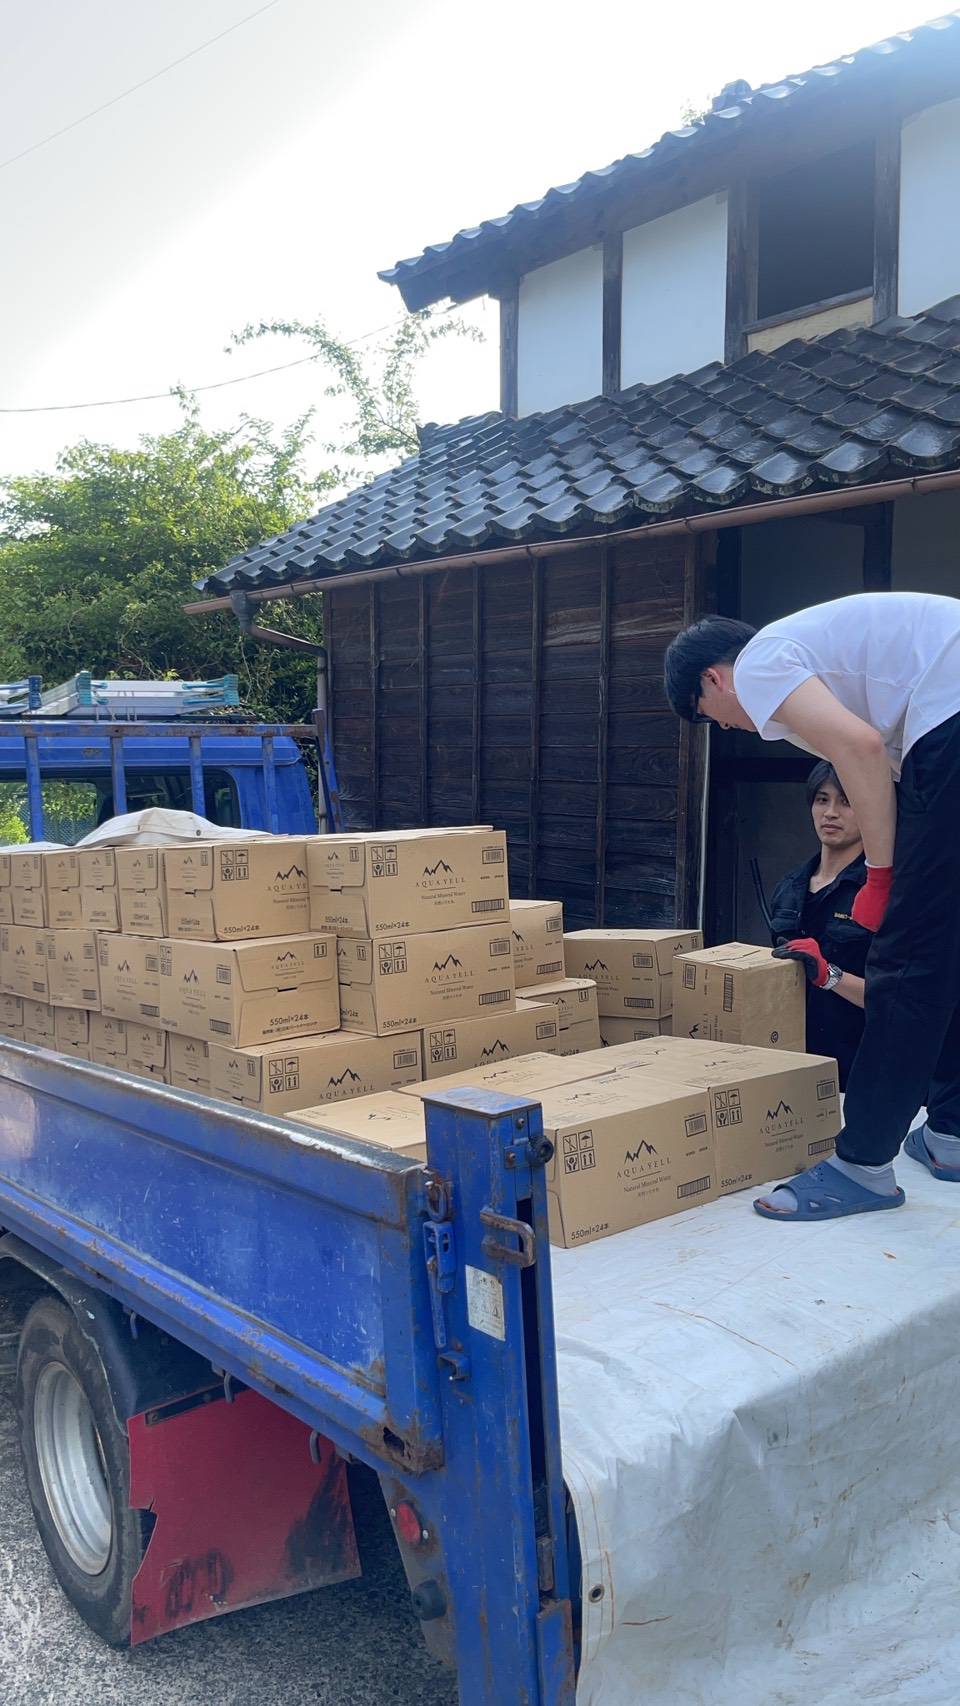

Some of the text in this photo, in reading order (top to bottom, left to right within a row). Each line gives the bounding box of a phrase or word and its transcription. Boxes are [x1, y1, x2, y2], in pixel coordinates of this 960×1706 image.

[267, 883, 308, 892] AQUAYE
[416, 877, 466, 888] AQUAYELL
[424, 971, 475, 983] AQUAYELL
[318, 1084, 376, 1100] AQUAYELL
[759, 1117, 805, 1134] AQUAYELL
[616, 1156, 671, 1179] AQUAYELL
[624, 1184, 641, 1193] Natural
[641, 1177, 658, 1188] Mineral
